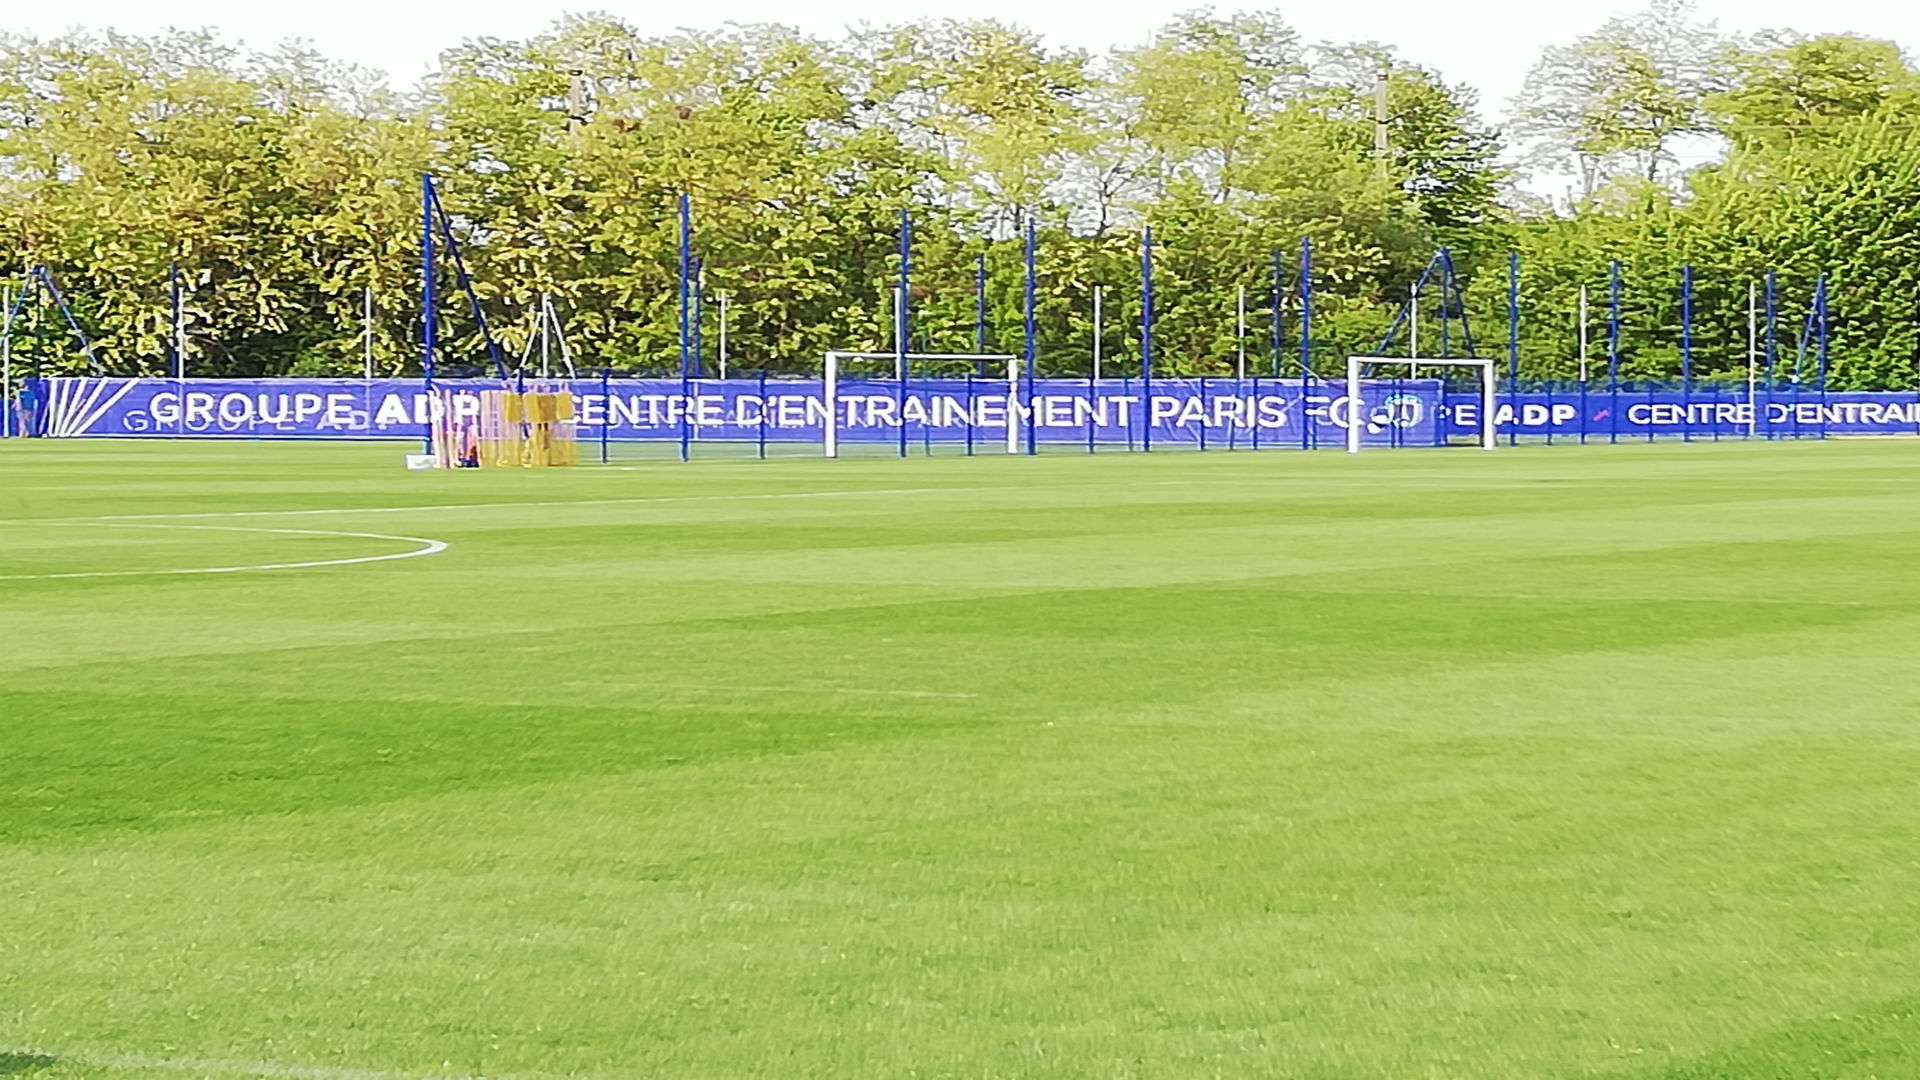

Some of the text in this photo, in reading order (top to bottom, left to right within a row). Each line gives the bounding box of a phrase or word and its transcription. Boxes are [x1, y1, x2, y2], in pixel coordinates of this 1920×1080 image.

[149, 392, 357, 424] GROUPE
[562, 395, 725, 426] ENTRE
[735, 395, 1139, 427] D'ENTRAINEMENT
[1151, 395, 1287, 428] PARIS
[1493, 404, 1576, 426] ADP
[1627, 403, 1756, 425] CENTRE
[1765, 403, 1920, 424] D'ENTRAI
